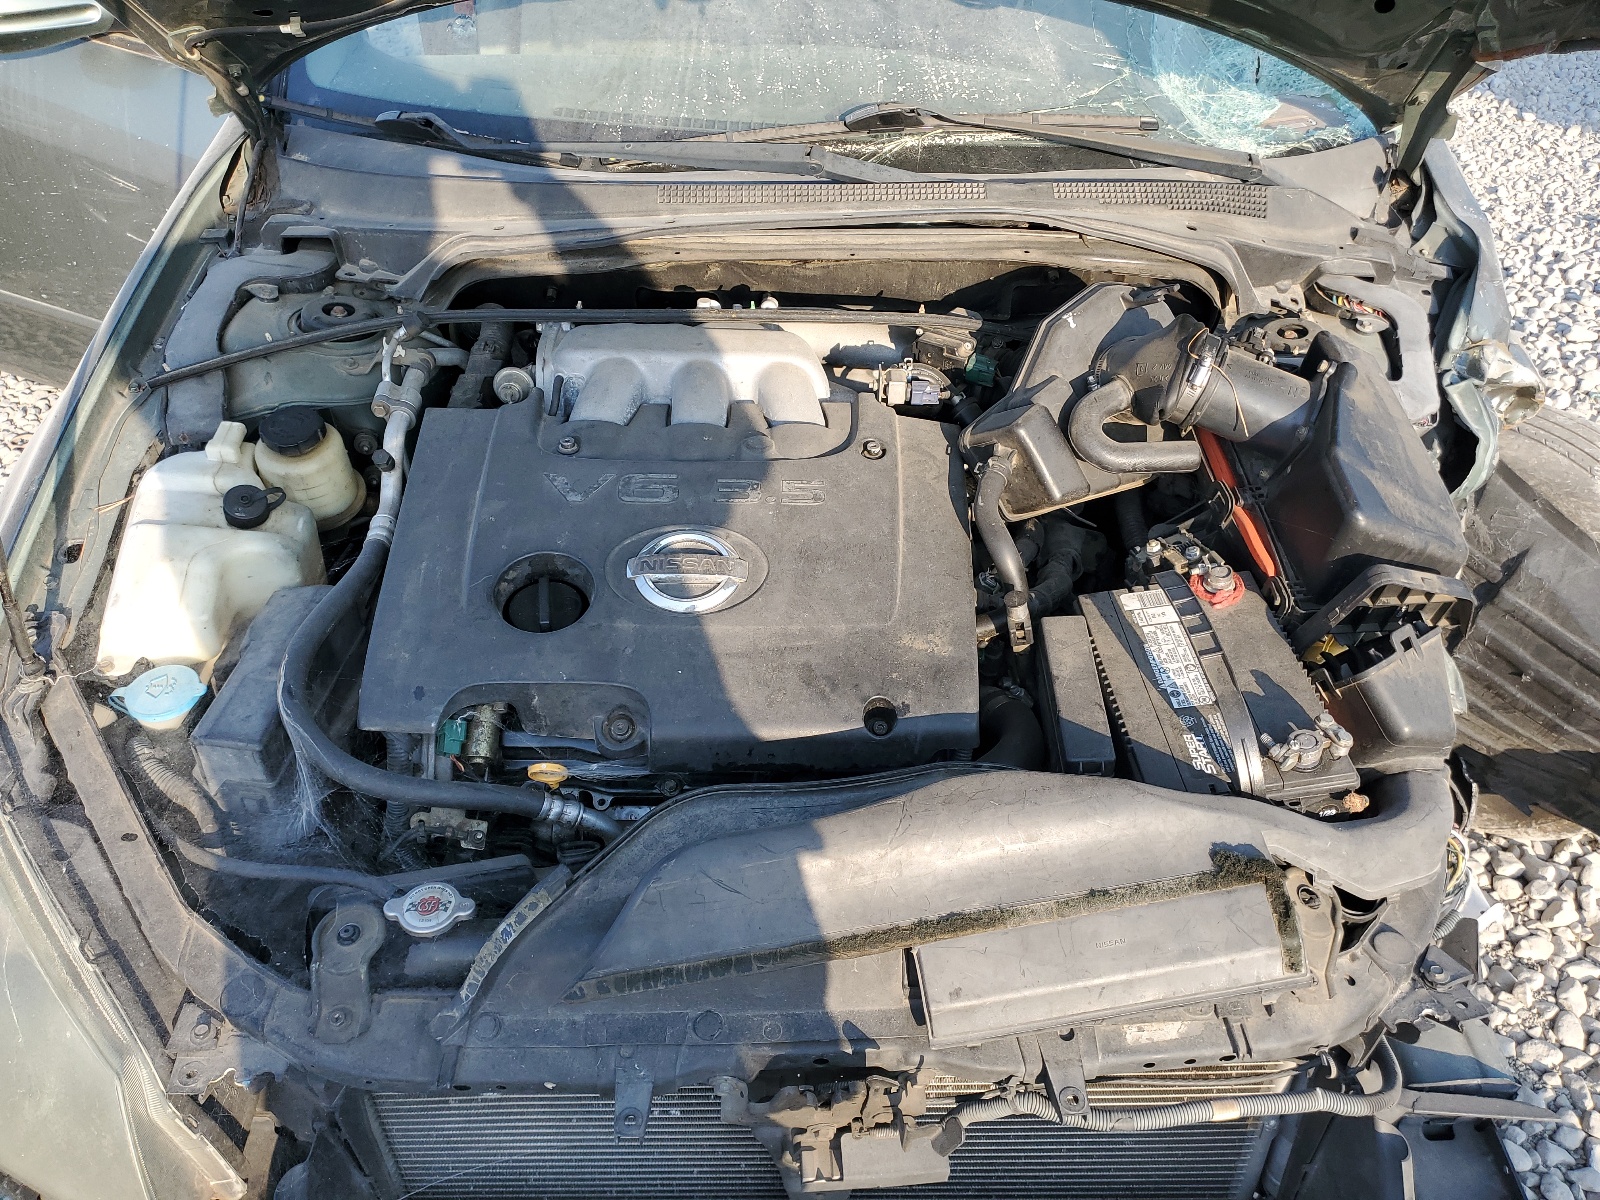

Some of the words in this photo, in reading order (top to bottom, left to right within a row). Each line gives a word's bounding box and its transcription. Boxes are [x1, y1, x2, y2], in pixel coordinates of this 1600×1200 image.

[543, 472, 680, 504] V6
[713, 478, 827, 505] 3.5
[639, 556, 734, 573] NISSAN
[1182, 733, 1203, 772] SUPER
[1193, 734, 1218, 775] START
[417, 900, 437, 911] CSF
[1095, 938, 1126, 948] NISSAN
